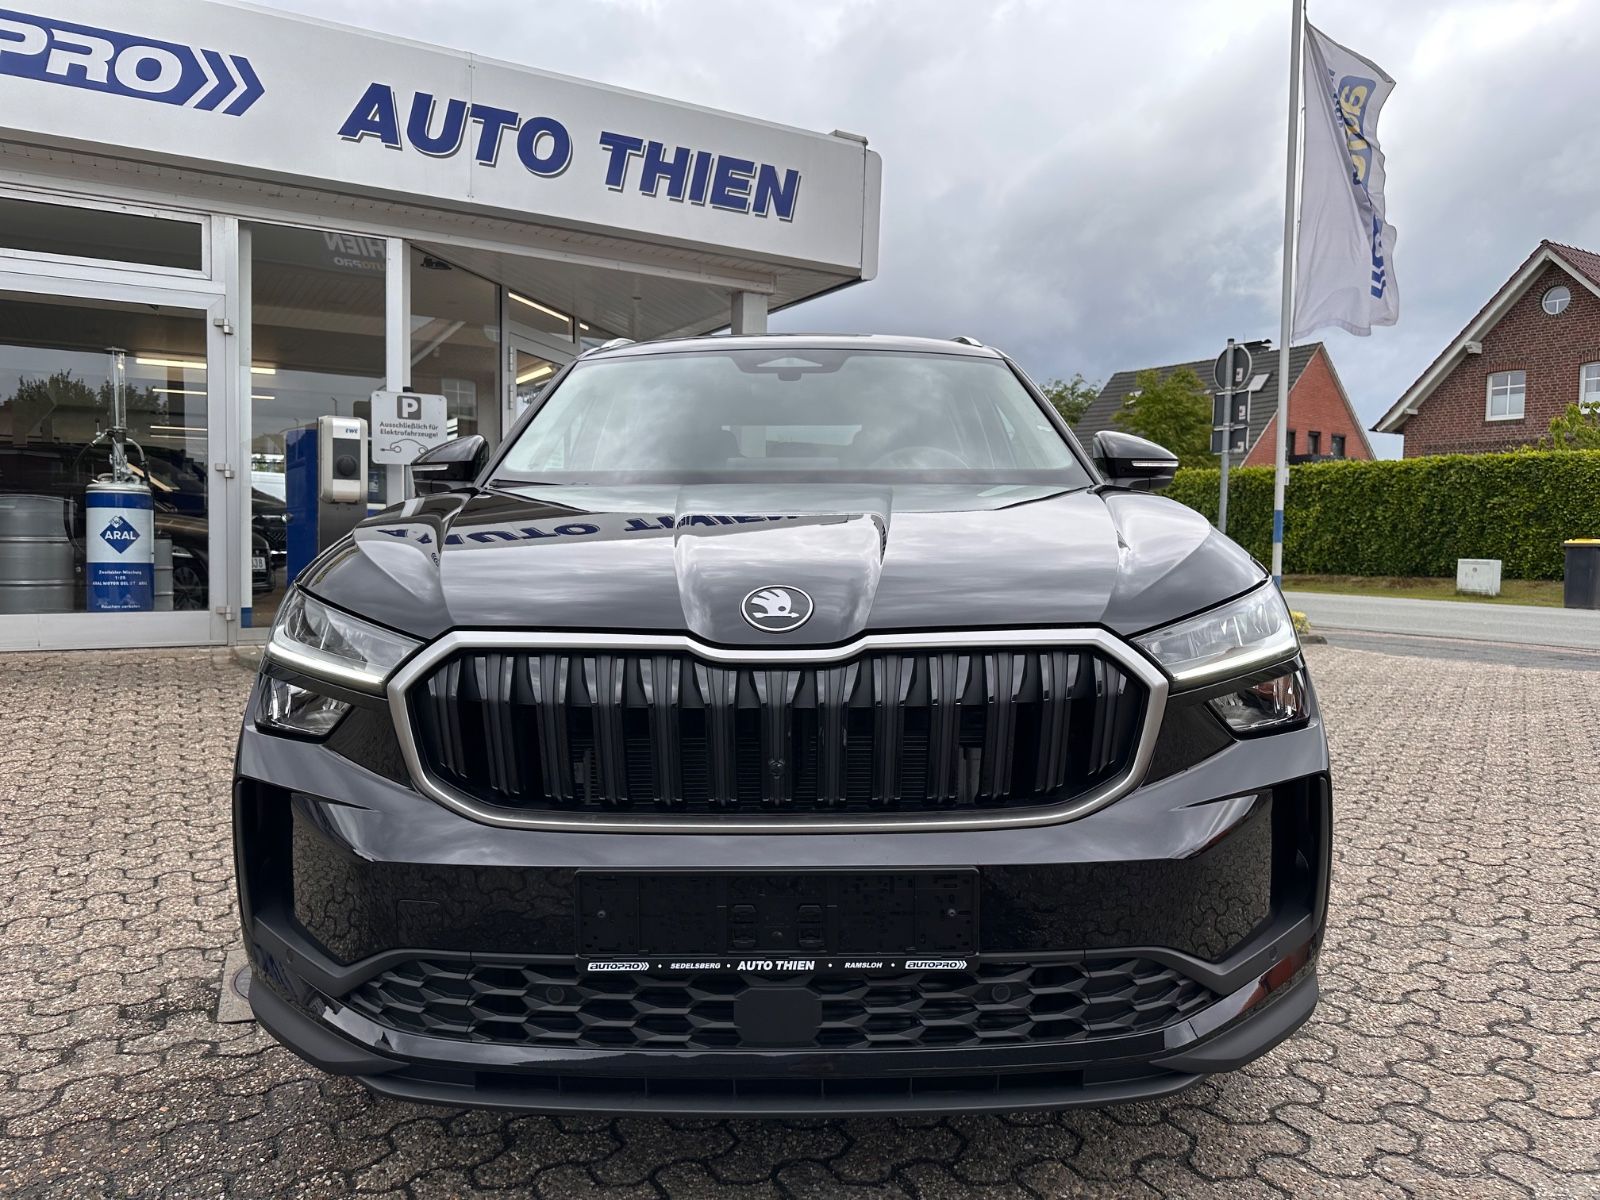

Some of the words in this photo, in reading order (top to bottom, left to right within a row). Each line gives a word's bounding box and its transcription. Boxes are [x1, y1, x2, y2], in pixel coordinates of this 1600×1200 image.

[0, 18, 183, 93] PRO
[337, 82, 572, 177] AUTO
[599, 130, 801, 222] THIEN
[402, 398, 418, 417] P
[380, 421, 428, 429] Ausschließlich
[104, 531, 136, 540] ARAL
[737, 961, 773, 971] AUTO
[776, 960, 815, 971] THIEN
